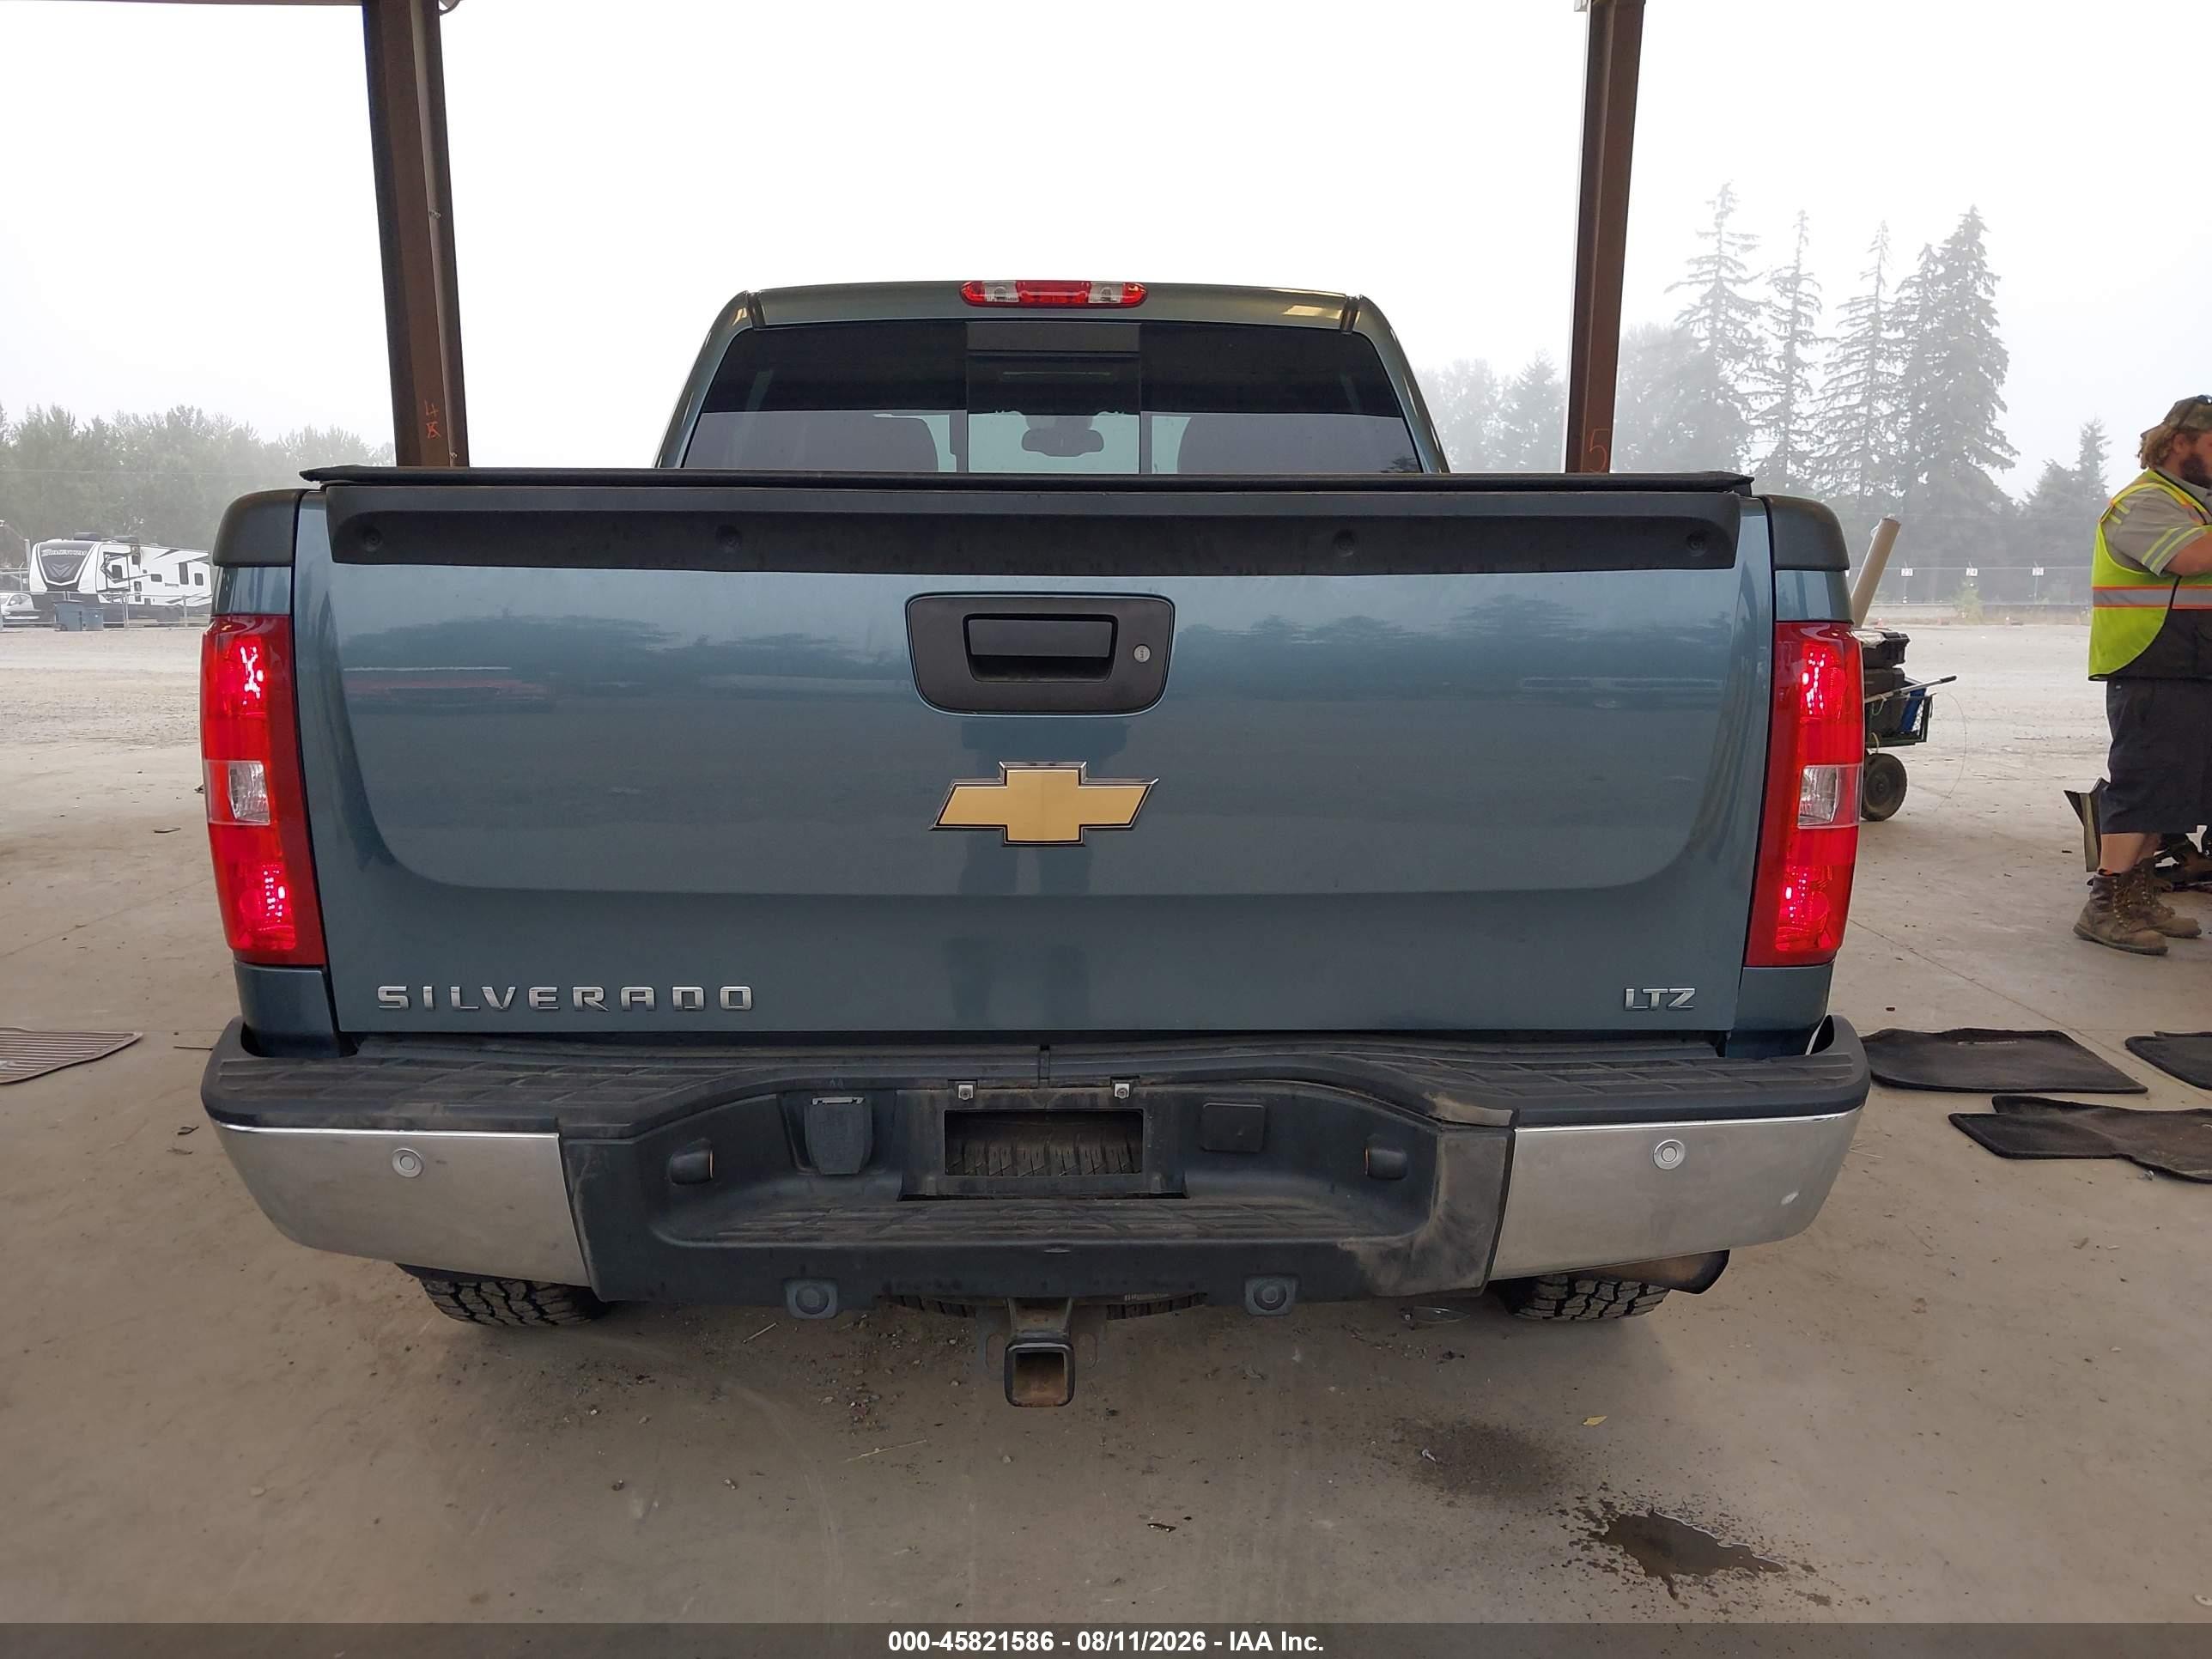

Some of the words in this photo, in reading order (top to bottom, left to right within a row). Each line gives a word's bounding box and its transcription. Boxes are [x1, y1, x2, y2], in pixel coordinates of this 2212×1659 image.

[1589, 428, 1609, 473] 5
[377, 985, 753, 1012] SILVERADO
[1624, 988, 1696, 1011] LTZ
